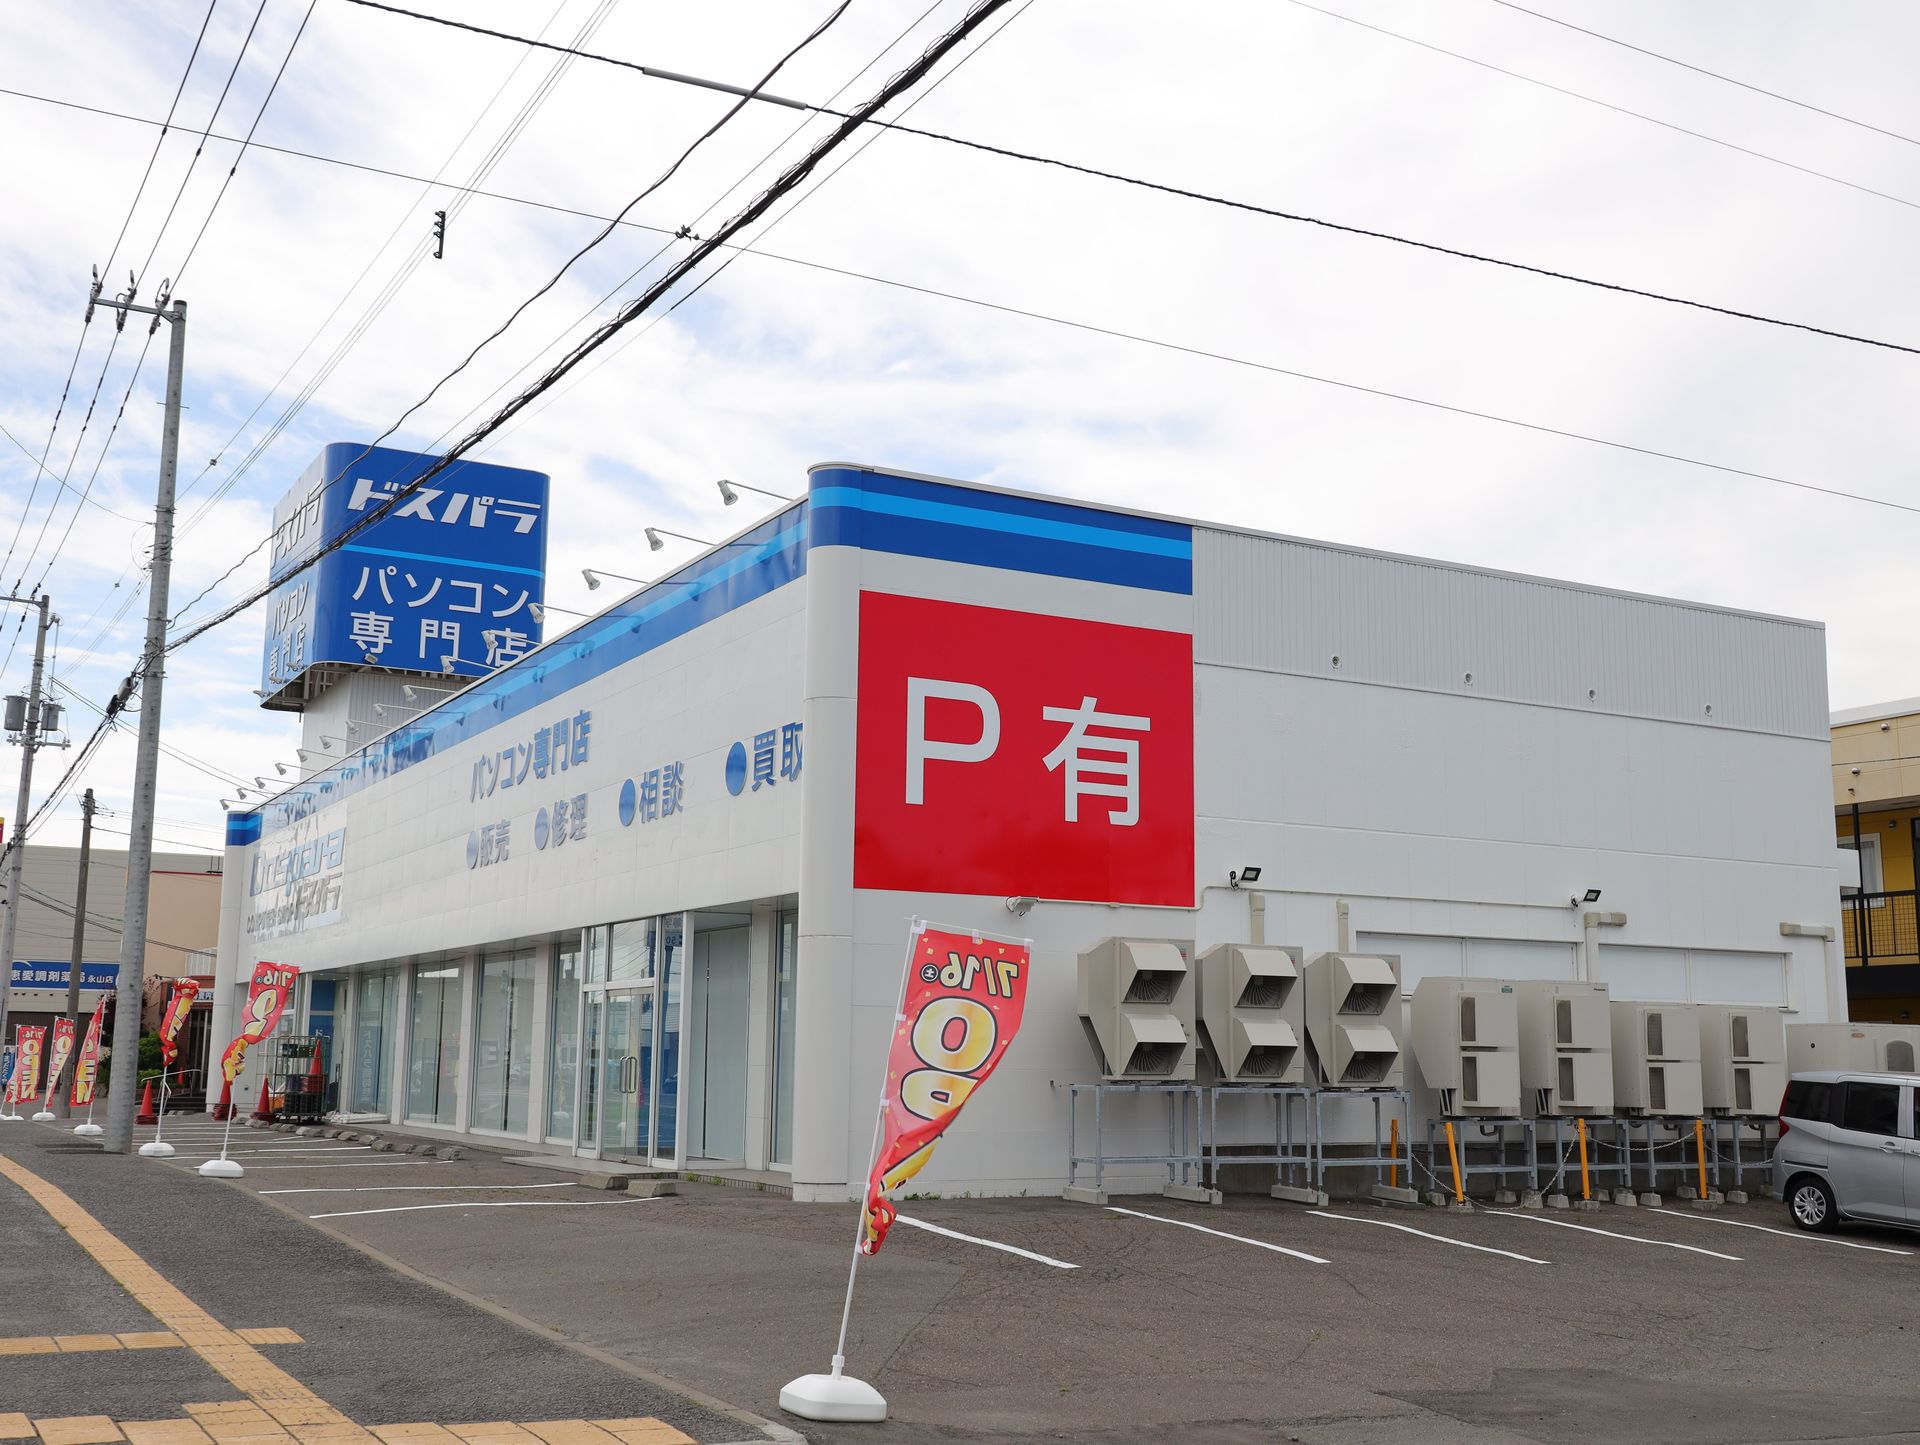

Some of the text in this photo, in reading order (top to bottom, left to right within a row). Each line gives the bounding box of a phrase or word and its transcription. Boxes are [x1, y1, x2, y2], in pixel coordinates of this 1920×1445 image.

[347, 478, 541, 534] ドスパラ
[272, 580, 310, 640] パソコン
[352, 565, 529, 618] パソコン
[349, 611, 527, 667] 専門店
[470, 709, 593, 803] パソコン専門店
[479, 722, 803, 868] 販売 修理 相談 買取
[88, 975, 114, 984] 永山店
